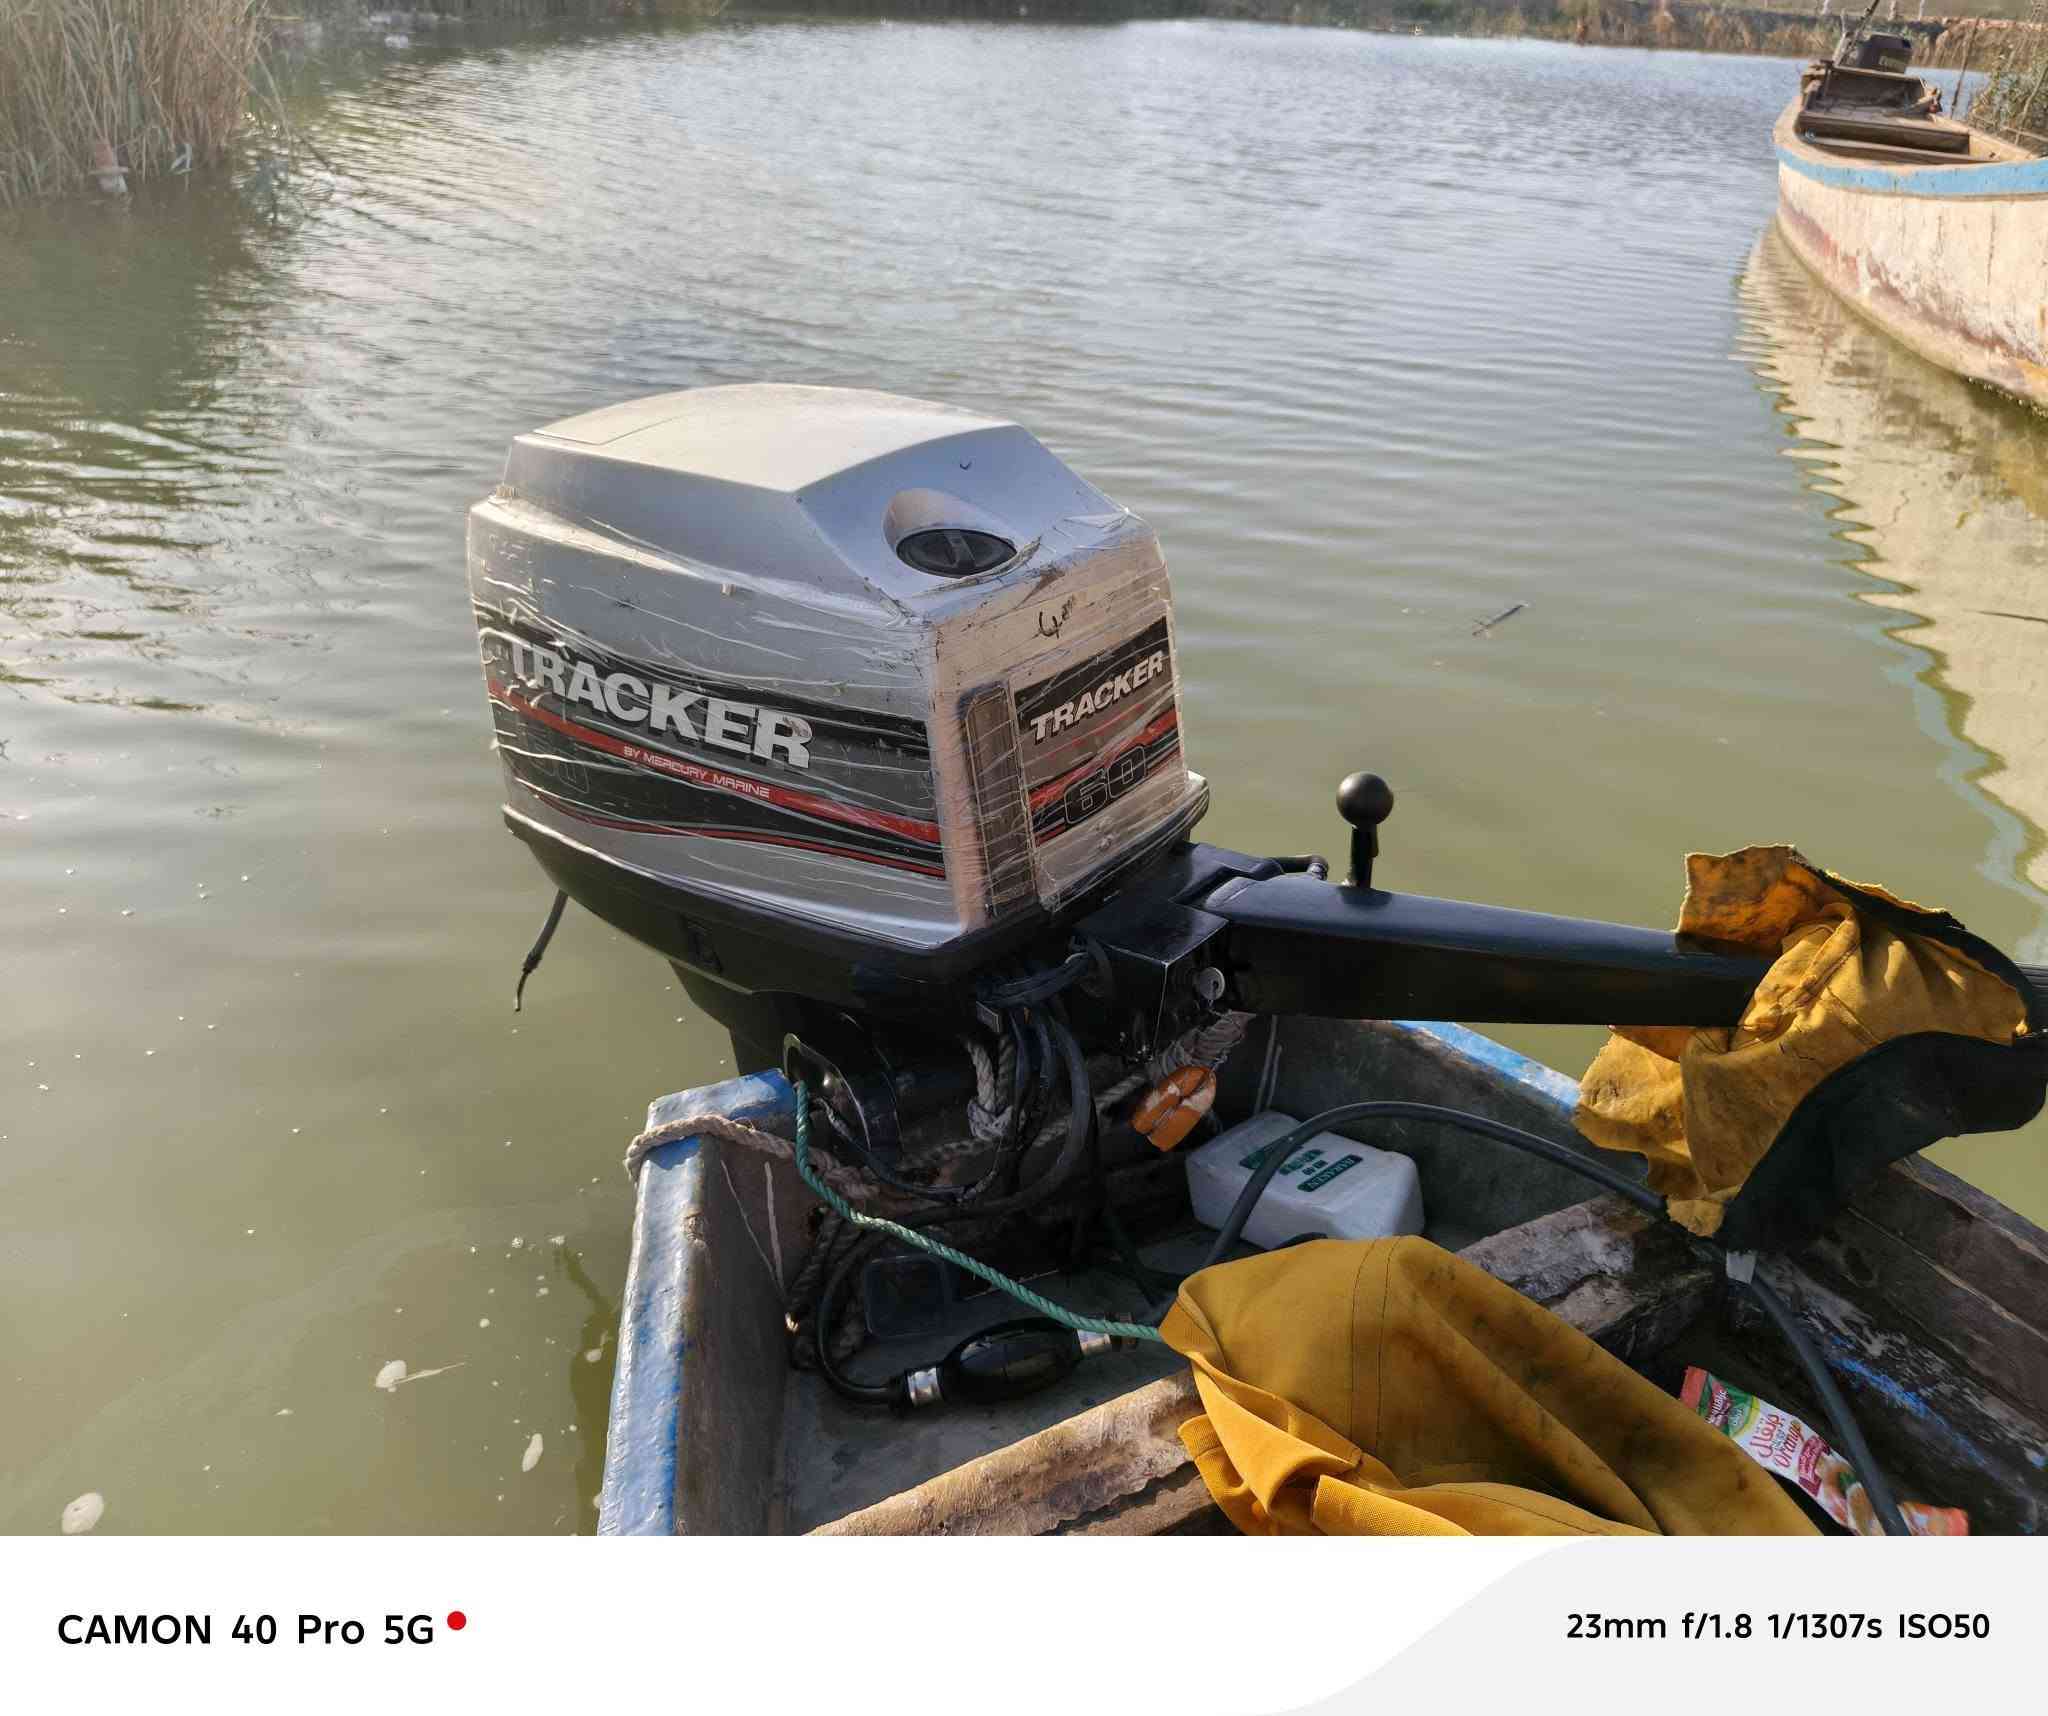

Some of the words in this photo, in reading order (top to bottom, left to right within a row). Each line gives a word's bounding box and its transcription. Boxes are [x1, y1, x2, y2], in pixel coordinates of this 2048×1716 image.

[506, 639, 814, 769] TRACKER
[1030, 650, 1165, 745] TRACKER
[623, 745, 641, 759] BY
[642, 753, 708, 781] MERCURY
[712, 773, 770, 798] MARINE
[1064, 745, 1147, 824] 60
